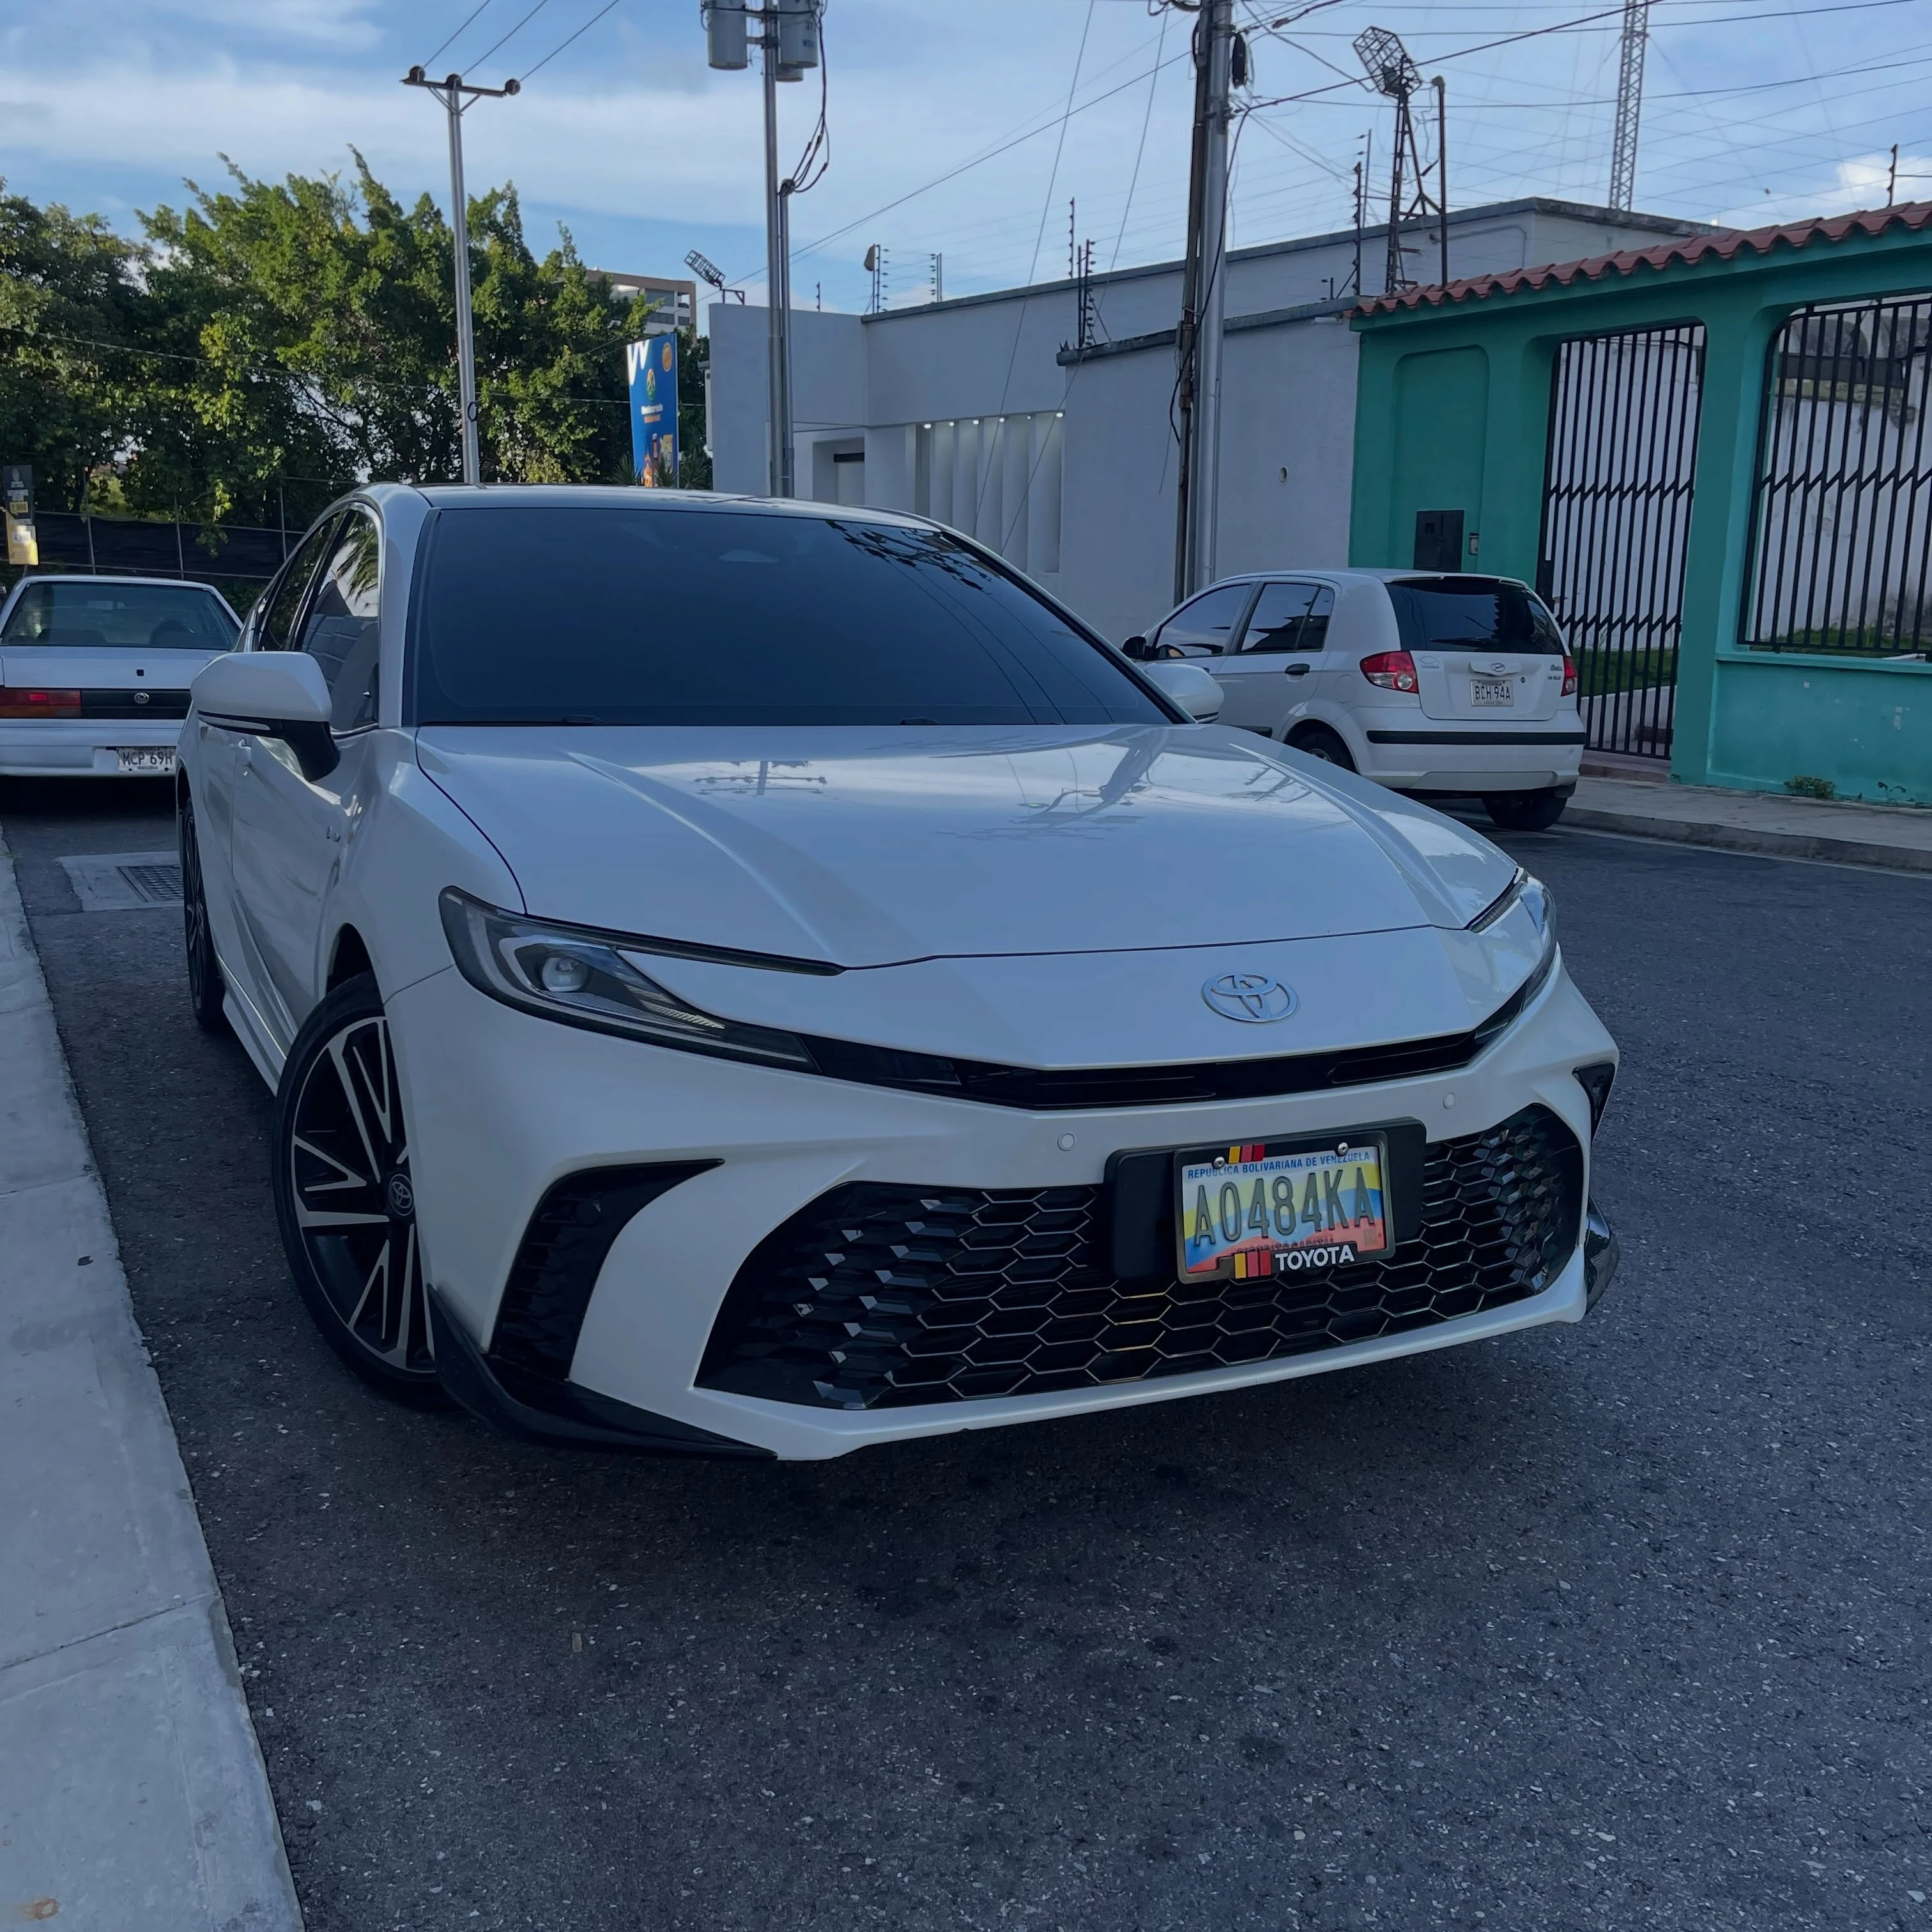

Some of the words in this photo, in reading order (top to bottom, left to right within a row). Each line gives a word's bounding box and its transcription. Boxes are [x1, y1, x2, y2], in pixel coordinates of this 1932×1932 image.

[1475, 686, 1491, 700] BCH
[1494, 686, 1510, 700] 94A
[150, 751, 172, 765] 69H
[1243, 1158, 1303, 1174] BOLIVARIANA
[1306, 1156, 1317, 1167] DE
[1320, 1151, 1370, 1165] VENEZUELA
[1275, 1245, 1355, 1271] TOYOTA
